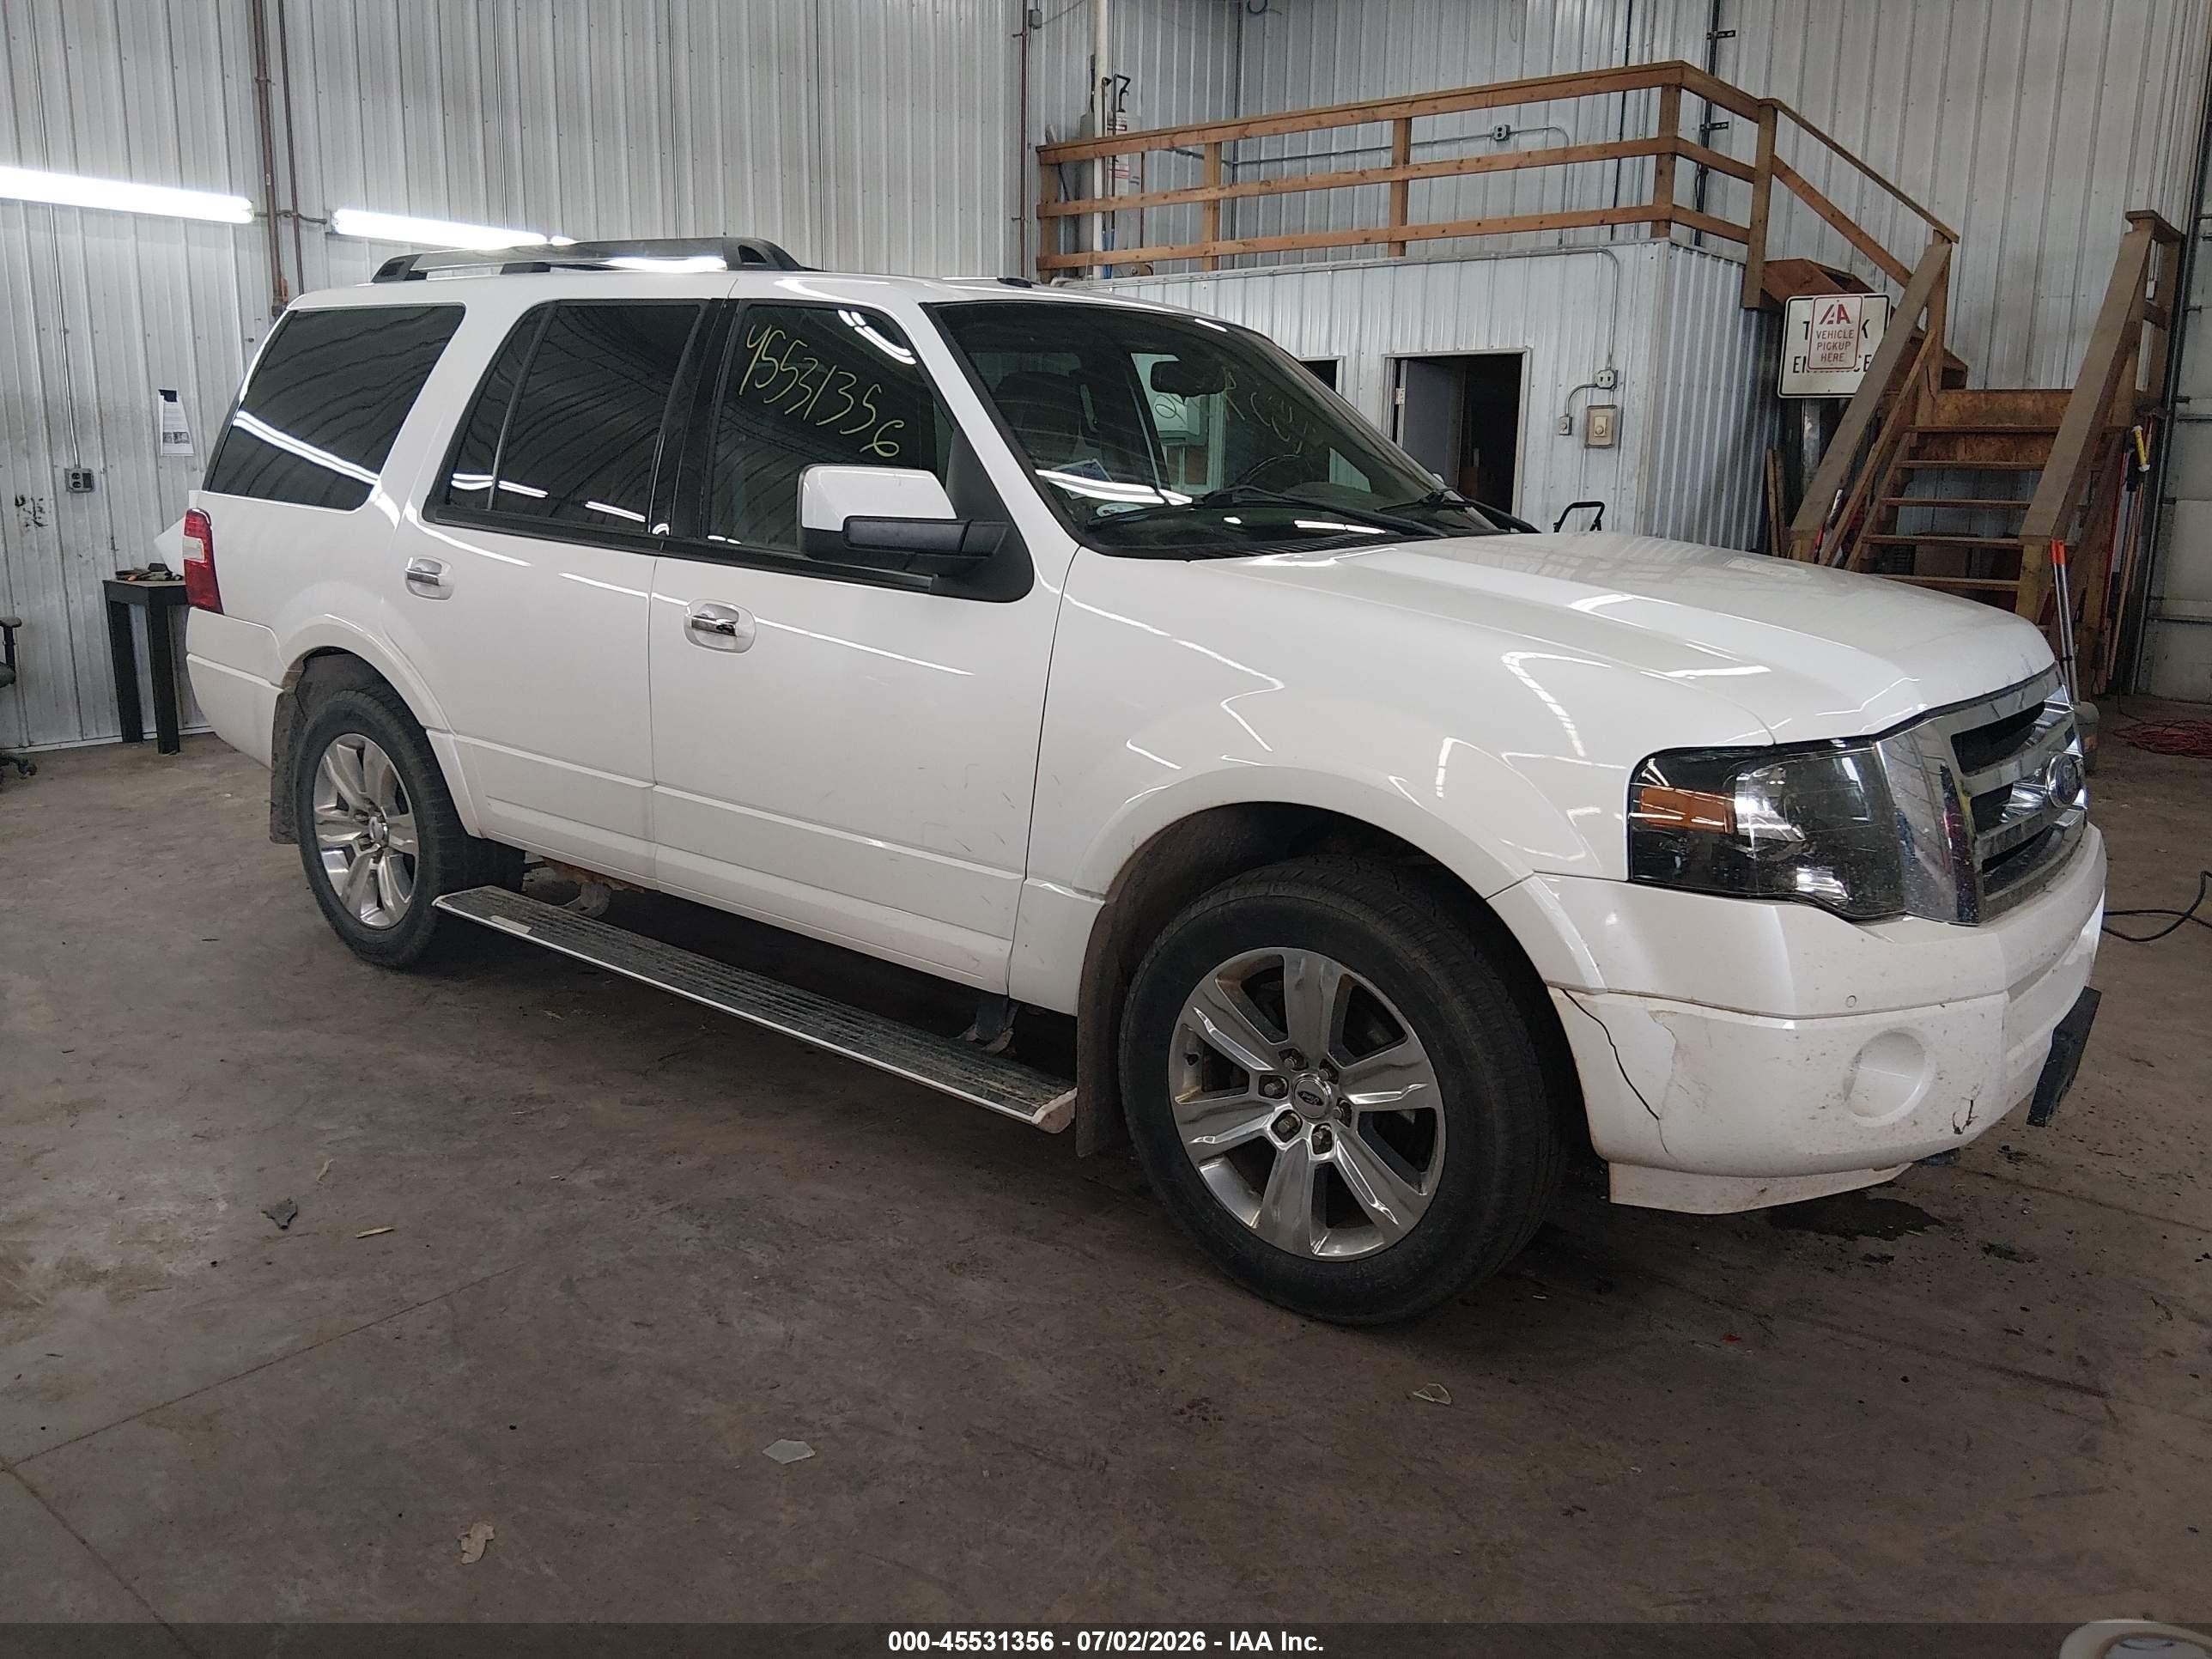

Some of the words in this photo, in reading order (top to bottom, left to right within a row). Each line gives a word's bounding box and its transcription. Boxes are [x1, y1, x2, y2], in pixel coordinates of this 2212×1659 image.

[1816, 329, 1855, 339] VEHICLE
[1816, 341, 1851, 351] PICKUP
[1820, 352, 1845, 362] HERE
